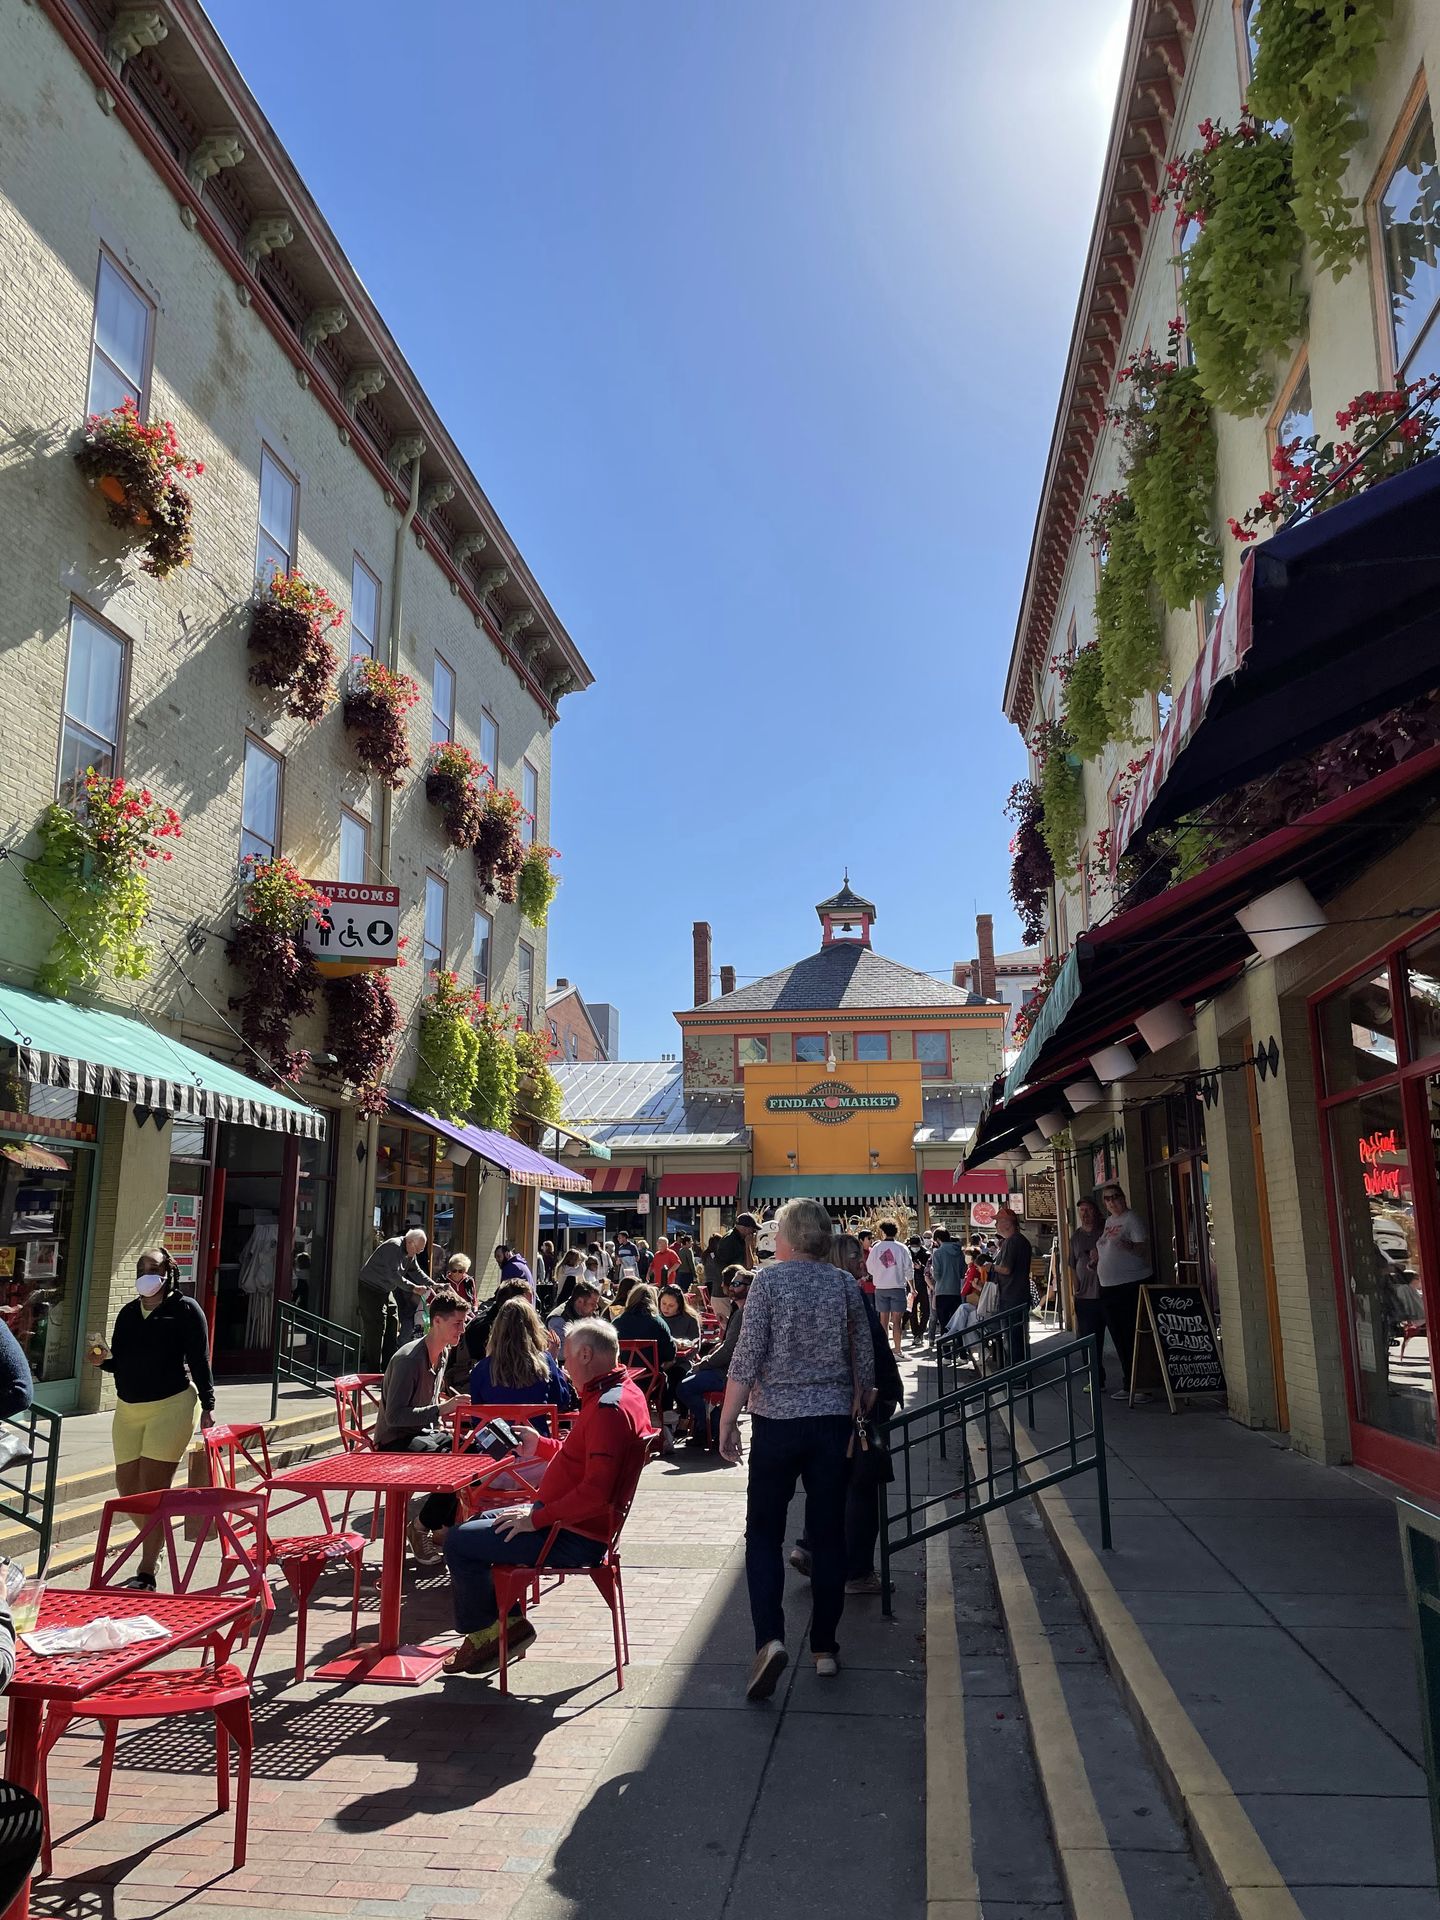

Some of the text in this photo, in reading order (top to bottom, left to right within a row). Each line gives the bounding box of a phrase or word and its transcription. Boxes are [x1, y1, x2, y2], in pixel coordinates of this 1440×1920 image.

[315, 886, 394, 902] STROOMS
[770, 1096, 896, 1109] FINDLAY MARKET
[813, 1112, 851, 1122] CINCINNATI
[1363, 1168, 1399, 1198] Delivery
[1159, 1296, 1194, 1310] SHOP
[1157, 1313, 1208, 1336] SILVER
[1166, 1334, 1214, 1352] GLADES
[1168, 1361, 1221, 1376] CHARCUTERIE
